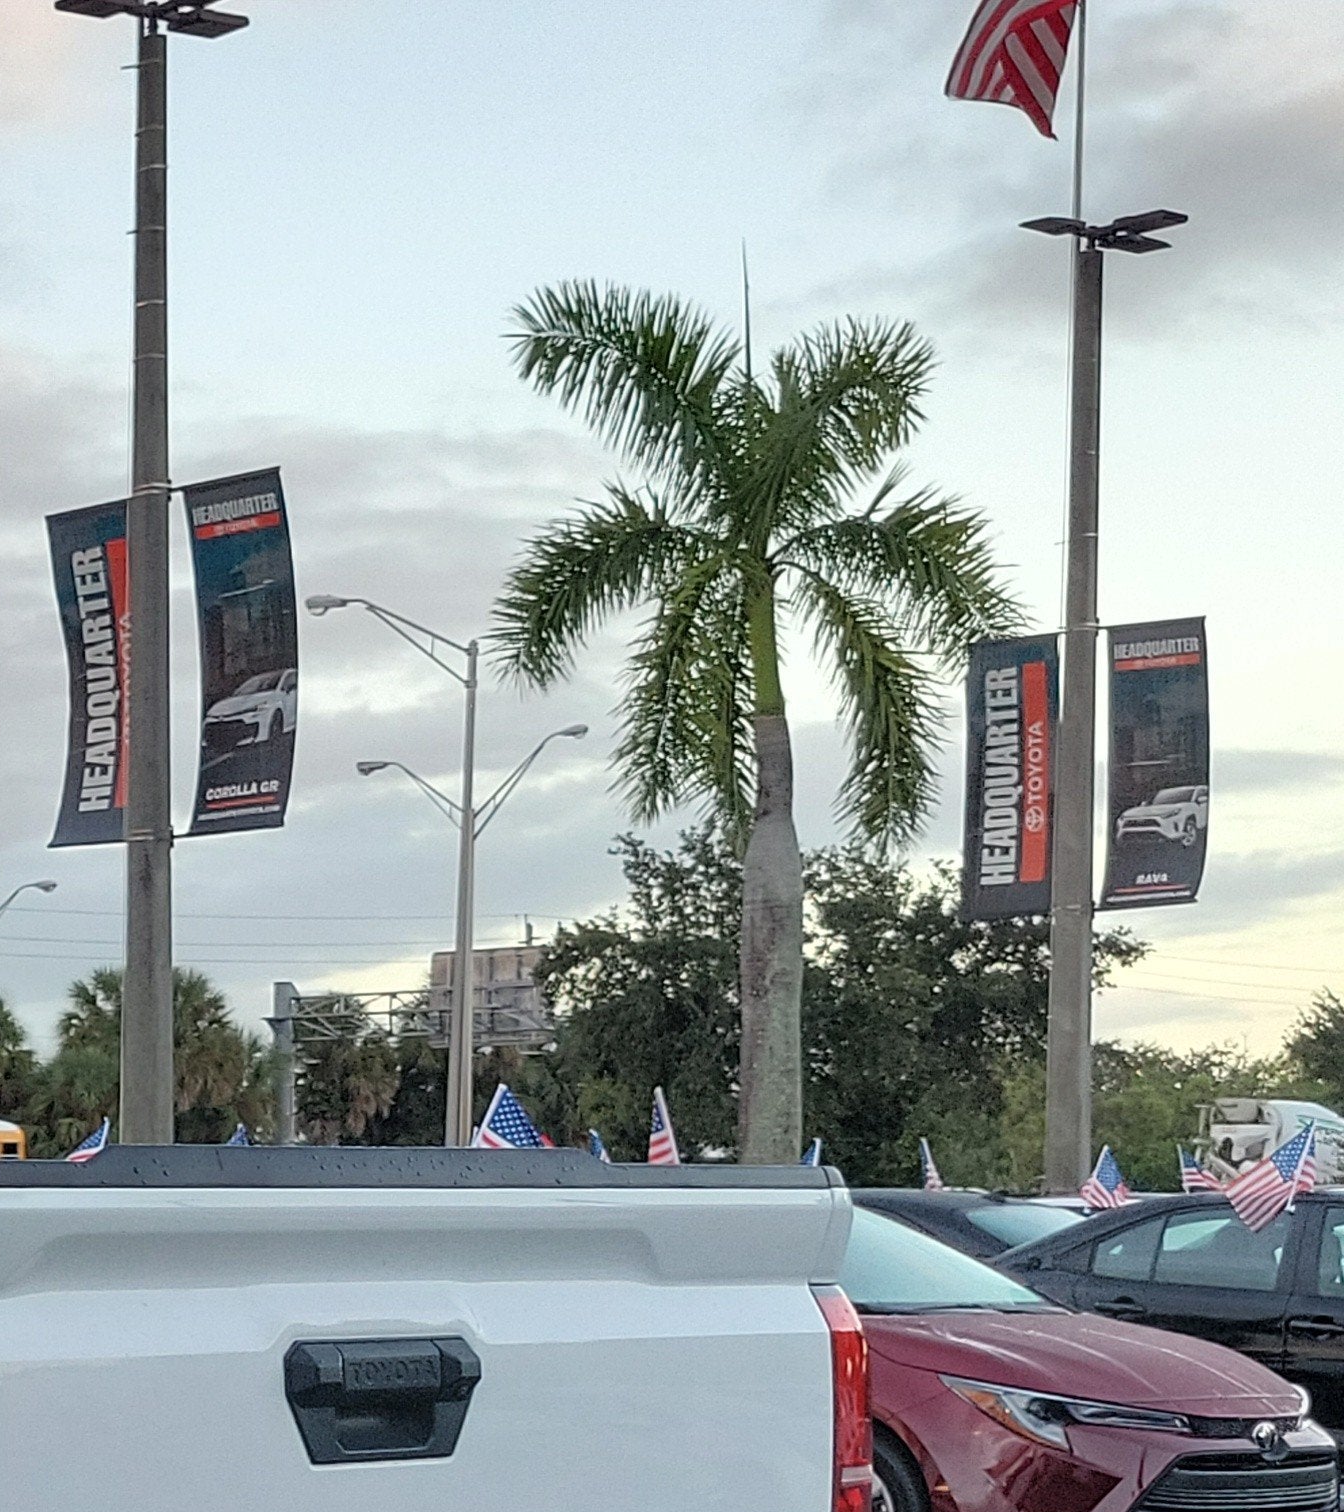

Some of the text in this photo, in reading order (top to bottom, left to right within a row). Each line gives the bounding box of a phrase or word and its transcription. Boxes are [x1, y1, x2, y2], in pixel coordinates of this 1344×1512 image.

[192, 492, 280, 527] HEADQUARTER
[1114, 637, 1199, 660] HEADQUARTER
[70, 545, 118, 813] HEADQUARTER
[980, 666, 1020, 886] HEADQUARTER
[1026, 721, 1045, 805] TOYOTA
[205, 780, 279, 801] COROLLA GR
[349, 1360, 438, 1383] TOYOTA
